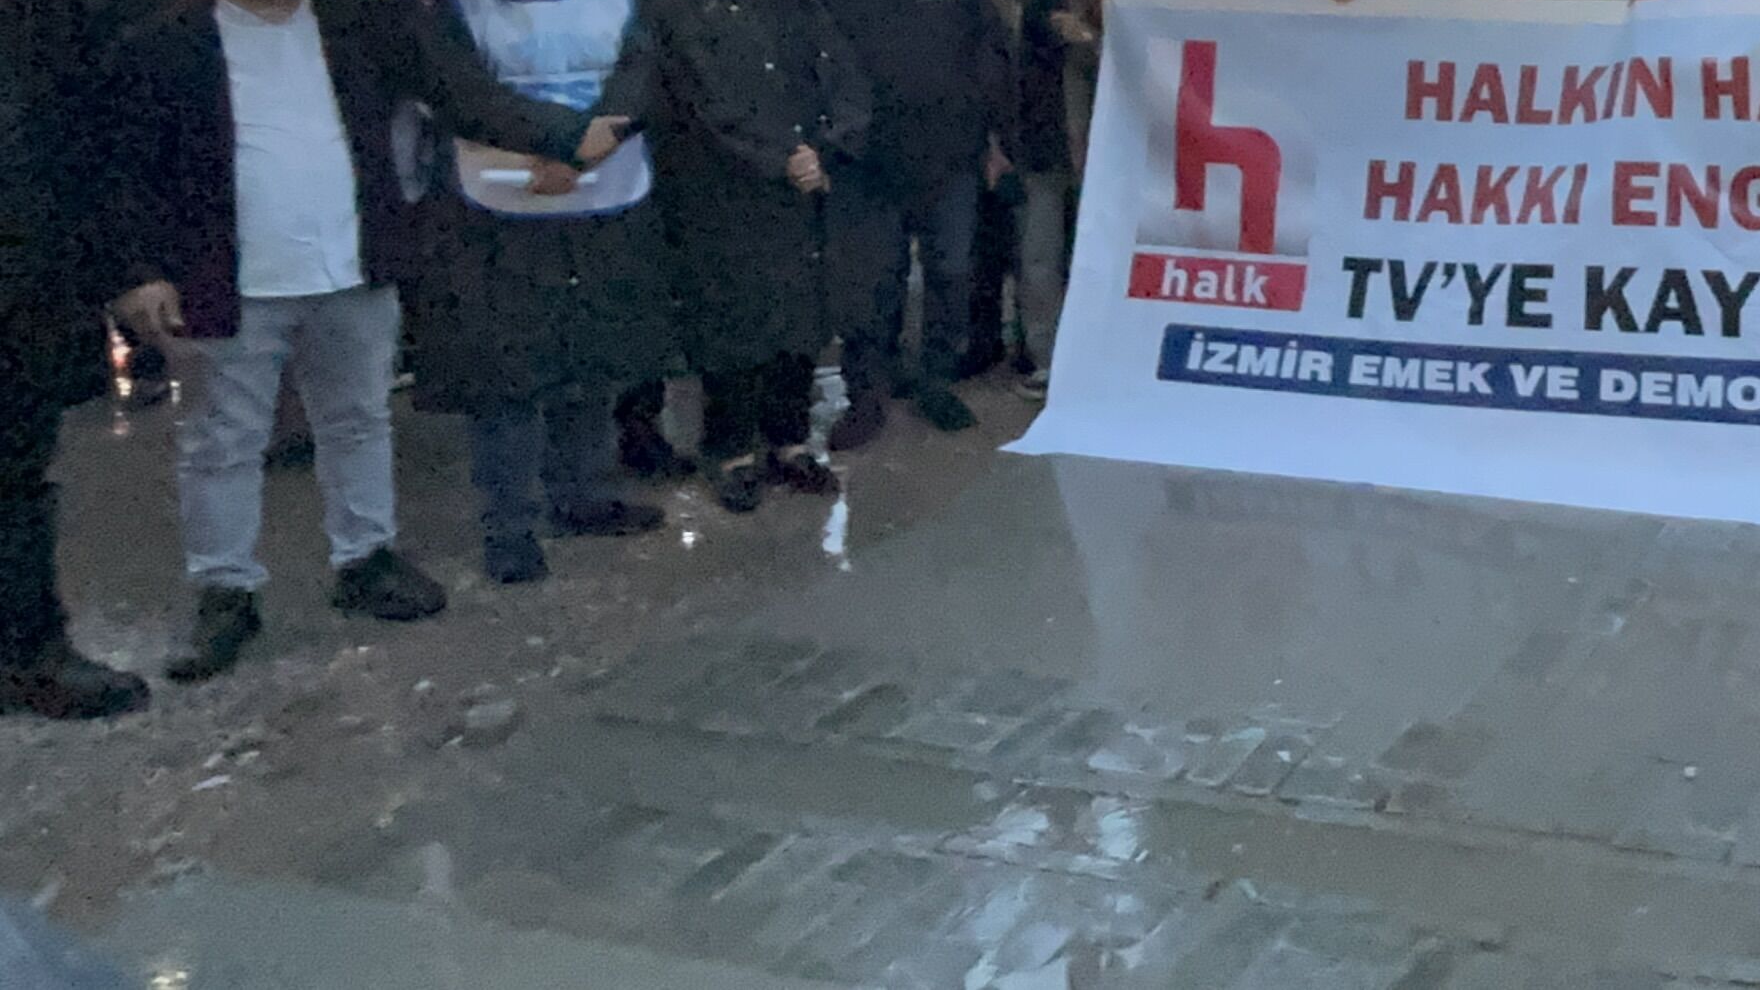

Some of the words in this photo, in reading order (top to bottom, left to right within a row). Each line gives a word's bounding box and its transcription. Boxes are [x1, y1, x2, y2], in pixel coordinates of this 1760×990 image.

[1404, 57, 1674, 126] HALKIN
[1364, 160, 1589, 224] HAKKI
[1161, 258, 1269, 305] halk
[1343, 256, 1555, 328] TV'YE
[1187, 332, 1333, 382] İZMİR
[1349, 354, 1493, 395] EMEK
[1509, 363, 1580, 400] VE
